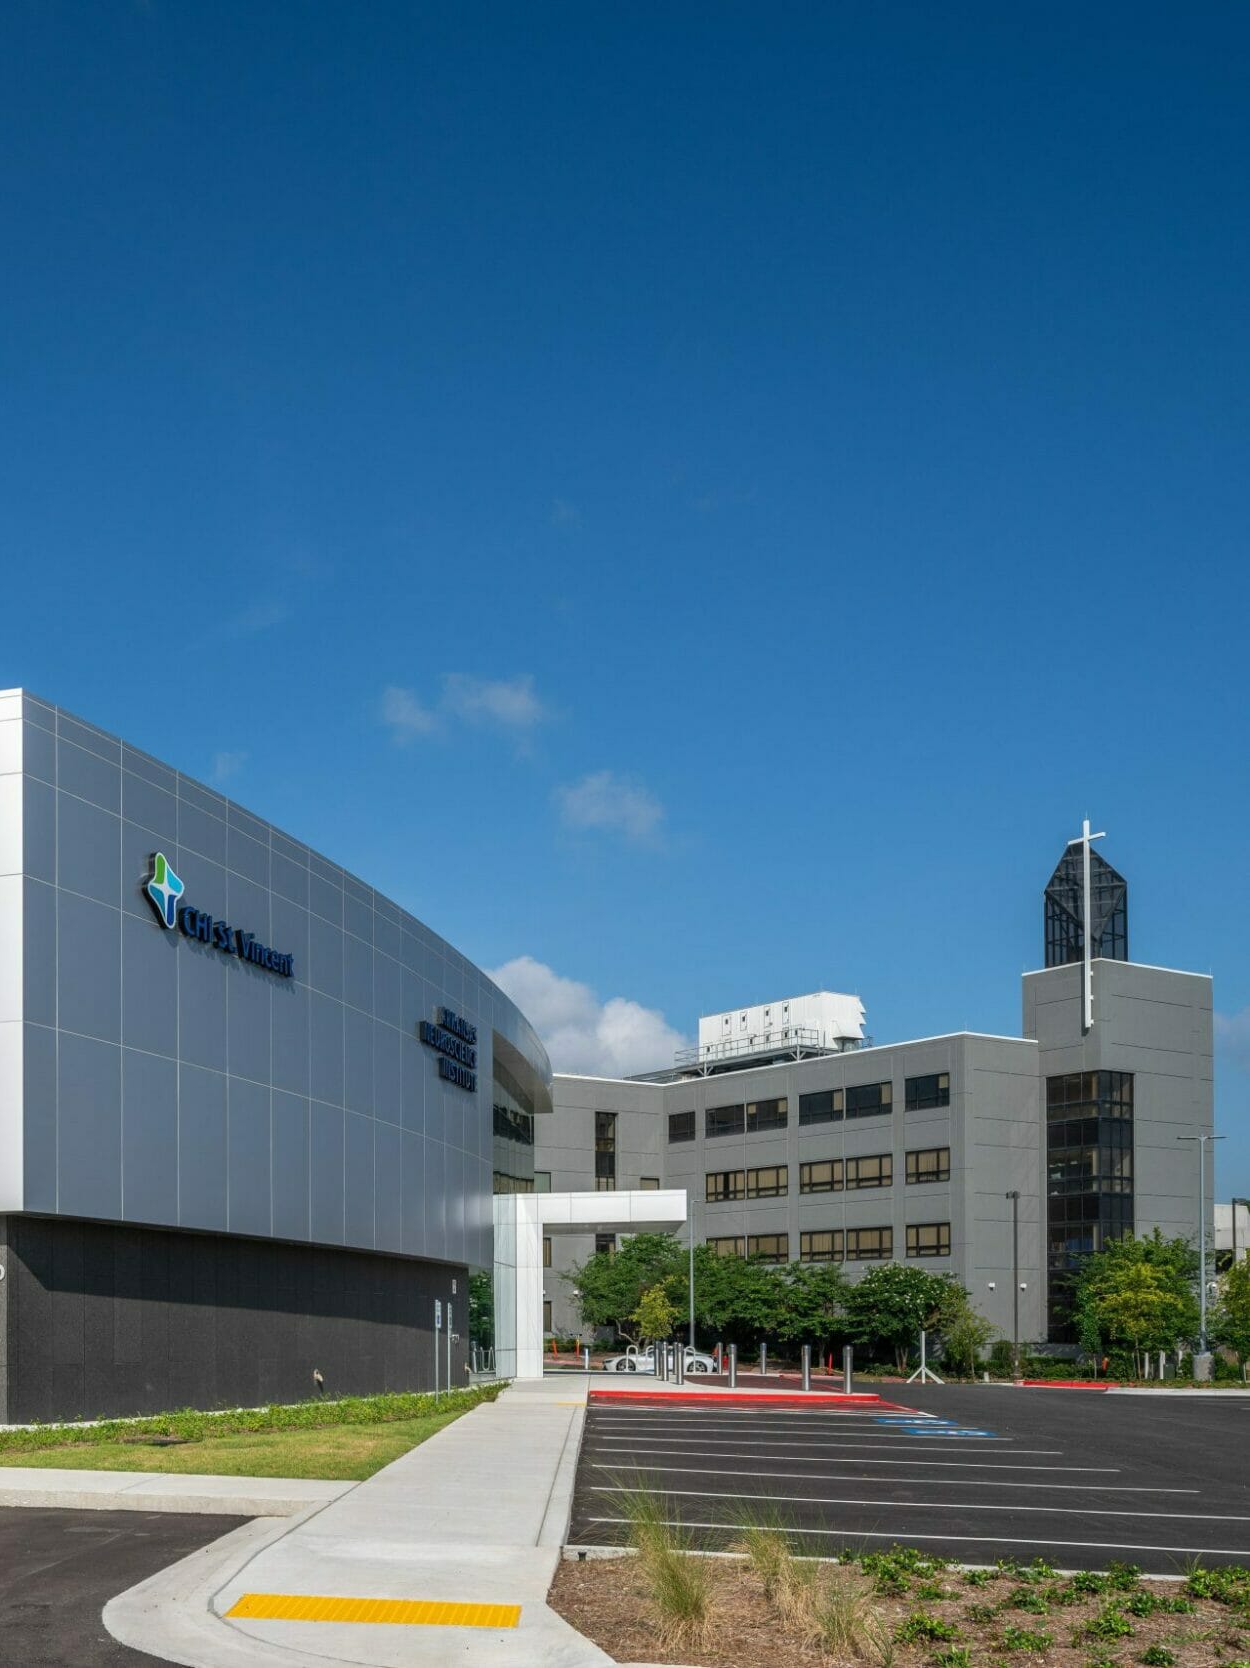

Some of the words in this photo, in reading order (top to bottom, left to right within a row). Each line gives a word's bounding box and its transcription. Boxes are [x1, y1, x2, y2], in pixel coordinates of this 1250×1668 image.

[179, 906, 213, 943] CHI
[213, 920, 236, 953] St.
[236, 929, 294, 977] Vincent
